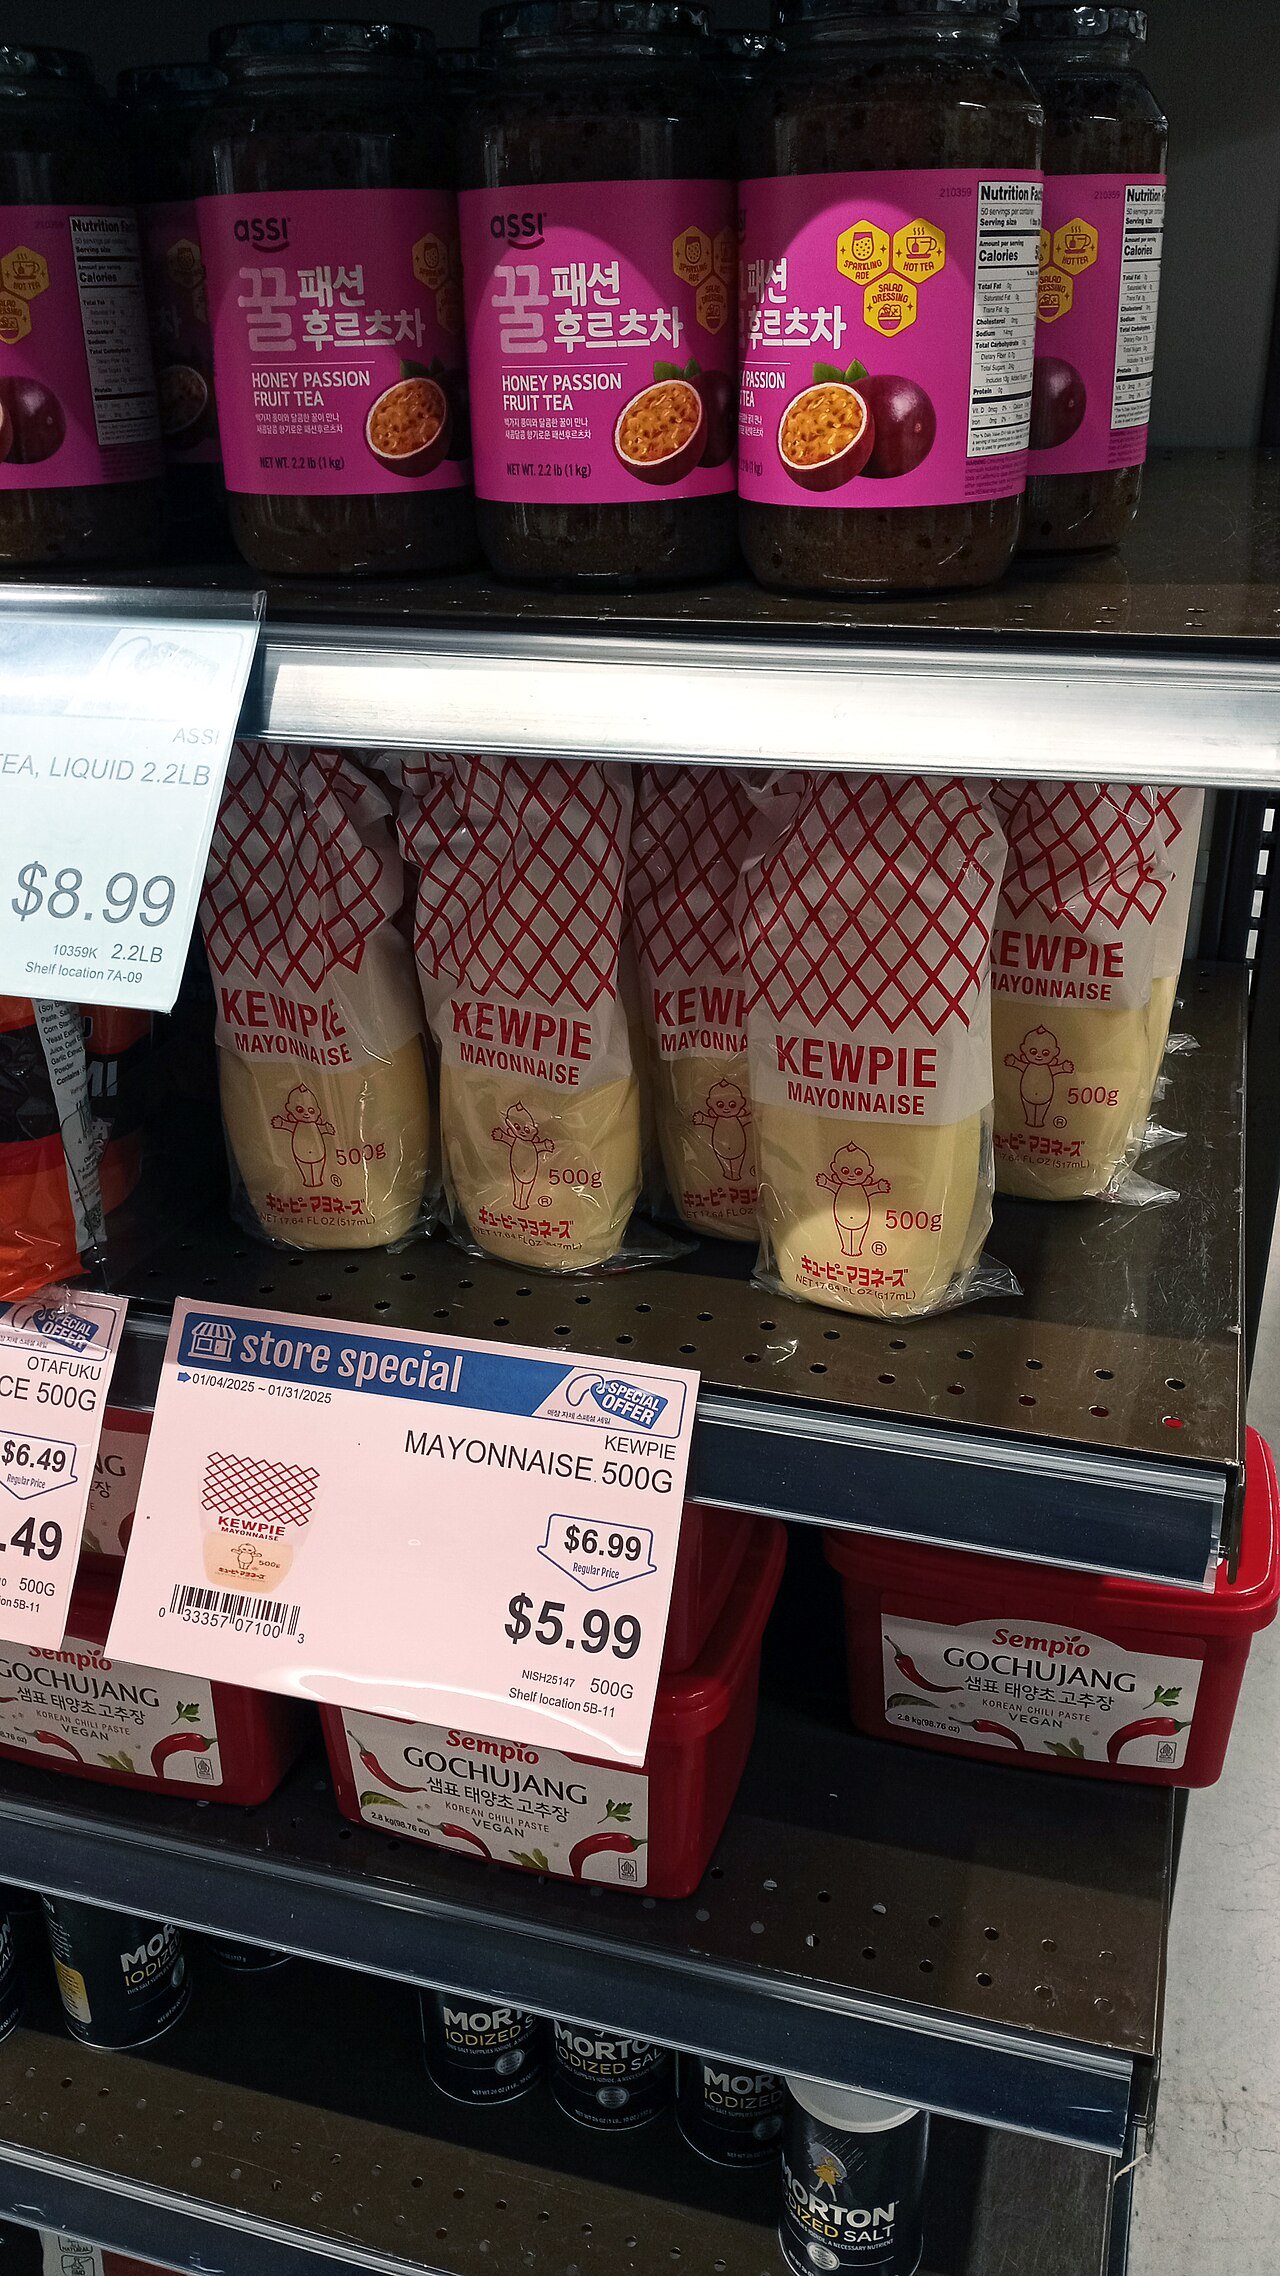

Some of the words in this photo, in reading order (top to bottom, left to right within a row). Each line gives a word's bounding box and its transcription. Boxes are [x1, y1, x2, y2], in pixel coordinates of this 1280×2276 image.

[939, 188, 972, 198] 210359
[980, 186, 1029, 201] Nutrition
[234, 217, 288, 242] assi
[490, 212, 543, 239] assi
[980, 218, 1005, 228] Serving
[1006, 218, 1017, 226] size
[979, 249, 1019, 262] Calories
[1124, 245, 1153, 256] Calories
[843, 259, 882, 270] SPARKLING
[855, 270, 869, 280] ADE
[903, 261, 919, 271] HOT
[920, 261, 934, 270] TEA
[80, 272, 117, 283] Calories
[747, 258, 788, 304] 패션
[878, 283, 903, 293] SALAD
[238, 266, 297, 352] 꿀
[297, 264, 366, 307] 패션
[491, 264, 551, 353] 꿀
[550, 260, 621, 307] 패션
[872, 293, 908, 304] DRESSING
[302, 308, 426, 352] 후르츠차
[553, 306, 684, 354] 후르츠차
[748, 305, 847, 350] 후르츠차
[251, 372, 298, 389] HONEY
[303, 370, 371, 388] PASSION
[502, 374, 549, 392] HONEY
[553, 372, 623, 391] PASSION
[745, 371, 786, 389] PASSION
[254, 390, 290, 408] FRUIT
[294, 391, 324, 406] TEA
[503, 394, 538, 412] FRUIT
[542, 394, 574, 411] TEA
[742, 390, 755, 408] TEA
[260, 457, 274, 470] NET
[291, 457, 305, 469] 2.2
[307, 457, 316, 468] lb
[329, 456, 344, 471] kg)
[507, 463, 520, 476] NET
[521, 463, 536, 476] WT.
[538, 464, 552, 476] 2.2
[553, 464, 563, 476] lb
[575, 464, 592, 479] kg)
[172, 727, 220, 746] ASSI
[0, 753, 39, 779] EA,
[49, 756, 135, 781] LIQUID
[140, 761, 212, 786] 2.2LB
[11, 860, 176, 928] $8.99
[53, 944, 98, 959] 10359K
[111, 943, 163, 963] 2.2LB
[25, 961, 57, 976] Shelf
[58, 963, 104, 980] location
[107, 969, 143, 984] 7A-09
[221, 987, 347, 1042] KEWPIE
[450, 998, 592, 1062] KEWPIE
[234, 1032, 353, 1067] MAYONNAISE
[774, 1034, 938, 1090] KEWPIE
[460, 1041, 580, 1086] MAYONNAISE
[787, 1080, 926, 1117] MAYONNAISE
[1067, 1086, 1120, 1107] 500g
[335, 1143, 387, 1166] 500g
[548, 1168, 603, 1189] 500g
[885, 1209, 944, 1232] 500g
[795, 1273, 814, 1287] NET
[27, 1356, 102, 1381] OTAFUKU
[239, 1330, 332, 1374] store
[337, 1349, 464, 1394] special
[36, 1381, 97, 1412] 500G
[192, 1372, 256, 1394] 01/04/2025
[268, 1385, 332, 1405] 01/31/2025
[607, 1381, 661, 1412] SPECIAL
[601, 1393, 655, 1426] OFFER
[1, 1440, 66, 1473] $6.49
[604, 1434, 677, 1462] KEWPIE
[7, 1473, 30, 1487] Regular
[30, 1475, 46, 1489] Price
[601, 1460, 673, 1495] 500G
[217, 1515, 286, 1537] KEWPIE
[220, 1526, 279, 1543] MAYONNAISE
[563, 1524, 642, 1562] $6.99
[572, 1562, 601, 1577] Regular
[601, 1566, 620, 1580] Price
[19, 1577, 56, 1597] 500G
[13, 1598, 41, 1614] 5B-11
[158, 1607, 166, 1619] 0
[182, 1608, 229, 1629] 33357
[234, 1618, 281, 1640] 07100
[297, 1633, 305, 1645] 3
[504, 1592, 643, 1660] $5.99
[991, 1627, 1091, 1660] Sempio
[942, 1646, 1137, 1694] GOCHUJANG
[521, 1669, 576, 1689] NISH25147
[590, 1677, 635, 1700] 500G
[964, 1674, 1000, 1696] 샘표
[1003, 1681, 1056, 1702] 태양초
[1056, 1690, 1115, 1713] 고추장
[17, 1686, 49, 1705] 샘표
[50, 1693, 97, 1716] 태양초
[99, 1702, 146, 1726] 고추장
[508, 1686, 538, 1704] Shelf
[539, 1692, 581, 1713] location
[582, 1701, 617, 1719] 5B-11
[981, 1698, 1023, 1712] KOREAN
[1026, 1705, 1055, 1719] CHILI
[1057, 1709, 1091, 1723] PASTE
[36, 1709, 72, 1724] KOREAN
[75, 1716, 101, 1730] CHILI
[101, 1723, 131, 1737] PASTE
[61, 1723, 109, 1742] VEGAN
[1008, 1712, 1064, 1730] VEGAN
[446, 1728, 540, 1766] Sempio
[402, 1746, 588, 1806] GOCHUJANG
[426, 1776, 461, 1799] 샘표
[464, 1784, 515, 1811] 태양초
[515, 1797, 571, 1825] 고추장
[445, 1800, 485, 1819] KOREAN
[488, 1810, 516, 1826] CHILI
[517, 1818, 551, 1835] PASTE
[471, 1817, 526, 1839] VEGAN
[445, 2025, 522, 2047] IODIZED
[704, 2086, 782, 2110] IODIZED
[843, 2223, 896, 2243] SALT
